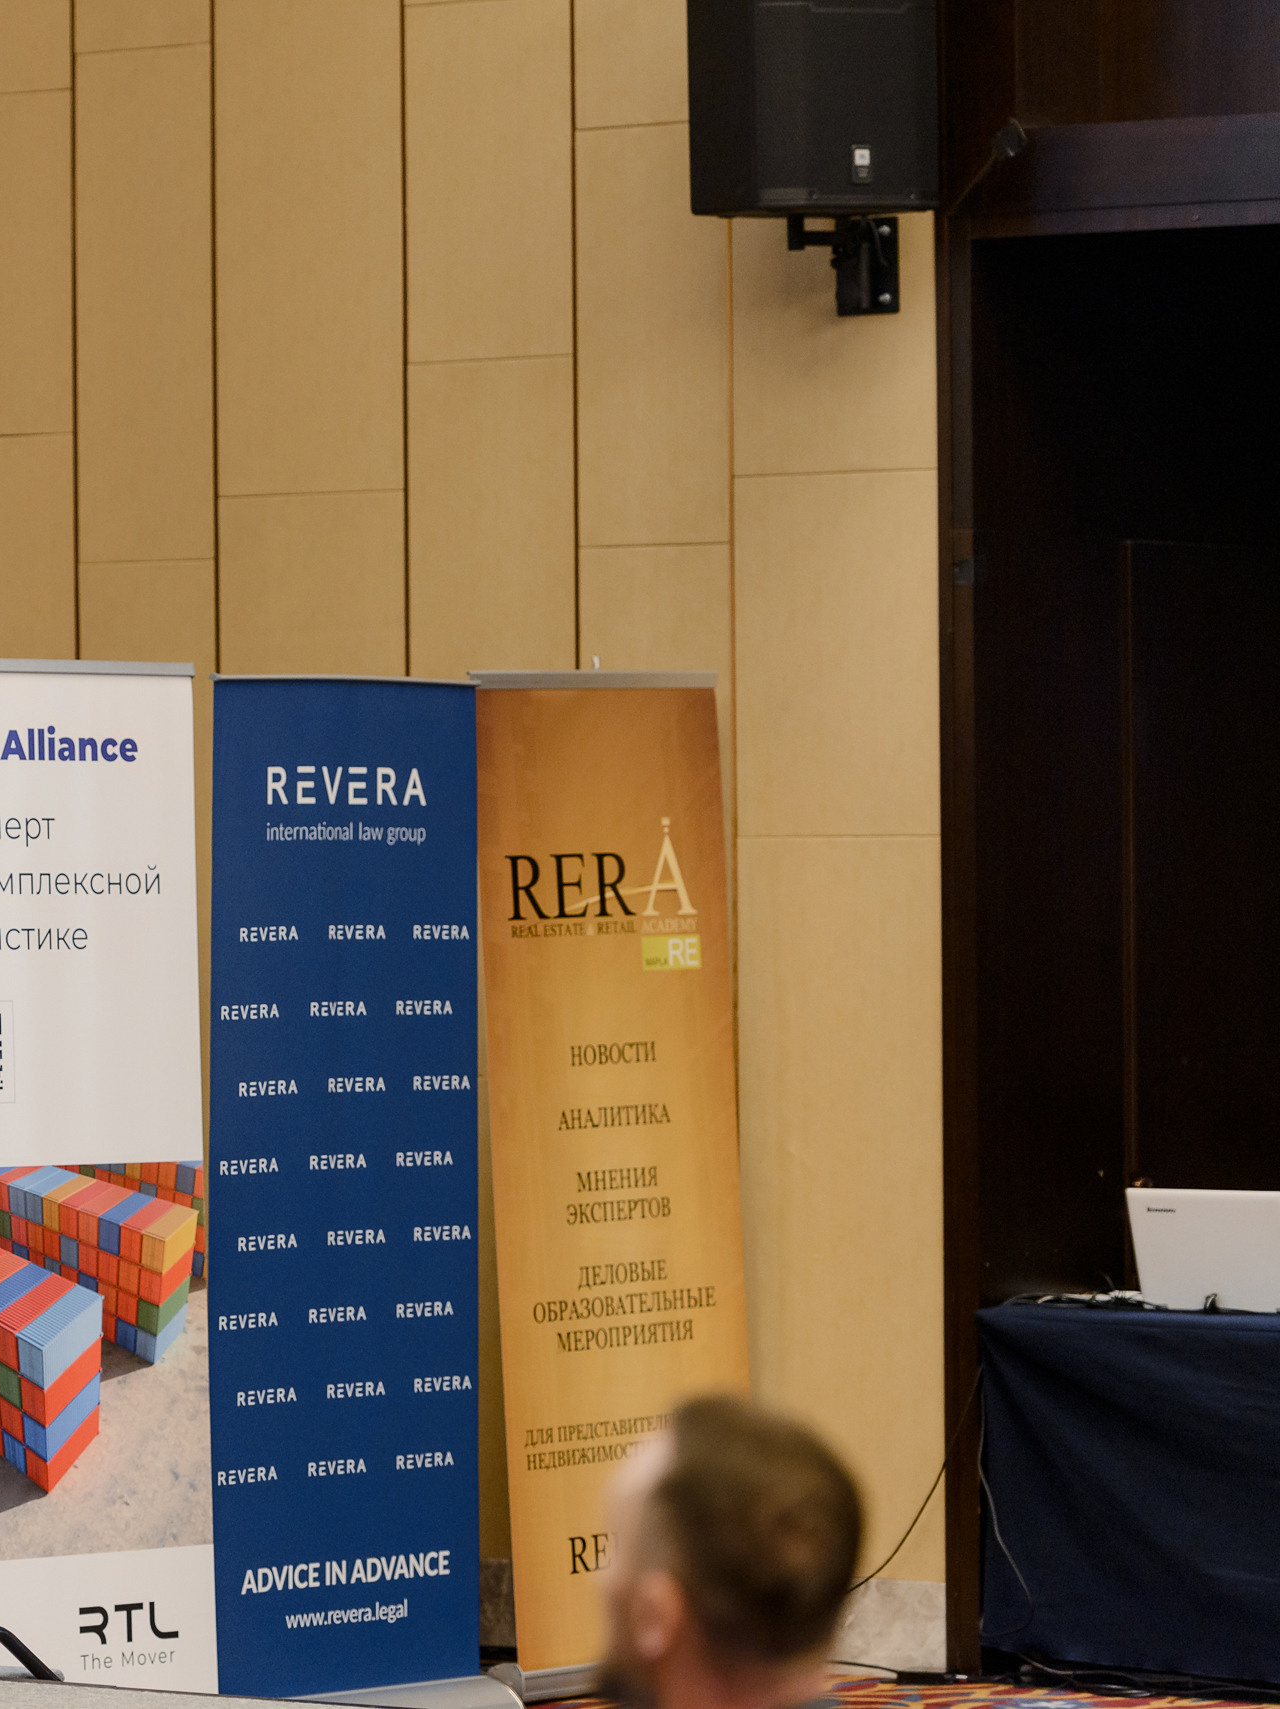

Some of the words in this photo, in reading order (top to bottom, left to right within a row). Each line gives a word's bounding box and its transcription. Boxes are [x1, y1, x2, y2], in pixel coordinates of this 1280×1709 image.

[0, 725, 138, 762] Alliance
[266, 765, 427, 807] REVERA
[266, 821, 354, 842] international
[358, 821, 384, 842] law
[386, 826, 427, 846] group
[505, 817, 698, 921] RERA
[240, 926, 298, 942] REVERA
[328, 925, 385, 940] REVERA
[413, 924, 470, 940] REVERA
[668, 937, 700, 967] RE
[220, 1004, 279, 1020] REVERA
[310, 1001, 367, 1016] REVERA
[396, 1000, 453, 1015] REVERA
[570, 1041, 657, 1067] НОВОСТИ
[239, 1080, 298, 1097] REVERA
[328, 1077, 386, 1092] REVERA
[413, 1076, 470, 1091] REVERA
[558, 1103, 671, 1131] АНАЛИТИКА
[219, 1158, 278, 1175] REVERA
[309, 1154, 367, 1170] REVERA
[396, 1151, 453, 1167] REVERA
[576, 1166, 658, 1193] МНЕНИЯ
[566, 1196, 671, 1226] ЭКСПЕРТОВ
[238, 1234, 297, 1251] REVERA
[327, 1230, 386, 1246] REVERA
[414, 1226, 471, 1241] REVERA
[578, 1259, 668, 1291] ДЕЛОВЫЕ
[219, 1312, 278, 1330] REVERA
[308, 1307, 367, 1323] REVERA
[396, 1302, 454, 1318] REVERA
[532, 1286, 717, 1325] ОБРАЗОВАТЕЛЬНЫЕ
[557, 1319, 694, 1353] МЕРОПРИЯТИЯ
[237, 1388, 297, 1406] REVERA
[327, 1382, 386, 1399] REVERA
[414, 1376, 471, 1392] REVERA
[524, 1427, 553, 1448] ДЛЯ
[217, 1466, 278, 1486] REVERA
[308, 1459, 367, 1477] REVERA
[396, 1452, 454, 1469] REVERA
[526, 1441, 644, 1471] НЕДВИЖИМОСТ
[568, 1530, 620, 1575] RE
[241, 1562, 320, 1595] ADVICE
[324, 1560, 347, 1586] IN
[350, 1550, 451, 1584] ADVANCE
[79, 1601, 179, 1645] RTL
[285, 1598, 409, 1630] www.revera.legal
[80, 1653, 113, 1671] The
[121, 1650, 175, 1667] Mover
